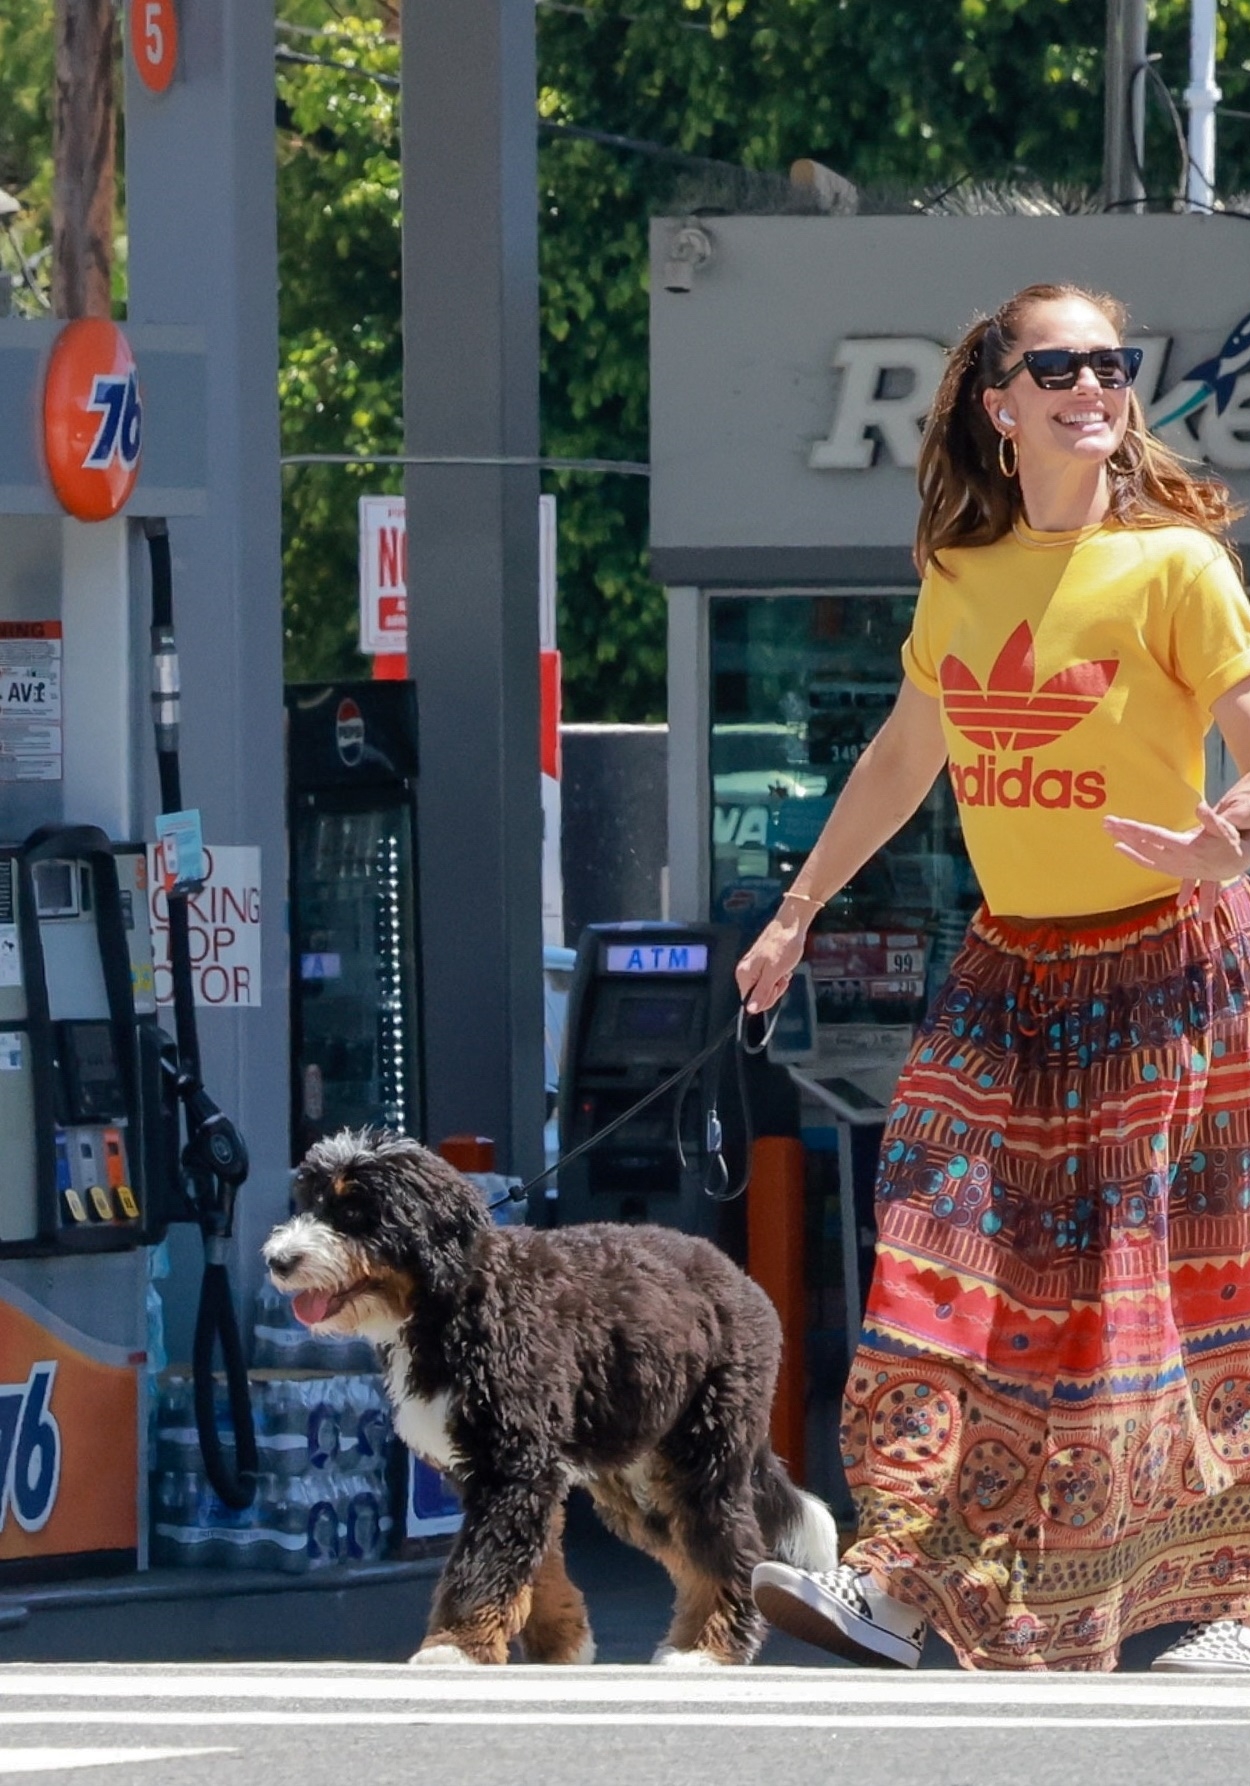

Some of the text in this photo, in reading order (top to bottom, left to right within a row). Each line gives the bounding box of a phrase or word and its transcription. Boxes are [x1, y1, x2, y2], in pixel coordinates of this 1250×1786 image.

[145, 3, 163, 65] 5
[82, 363, 142, 472] 76
[379, 526, 408, 588] N
[627, 948, 689, 970] ATM
[894, 953, 914, 974] 99
